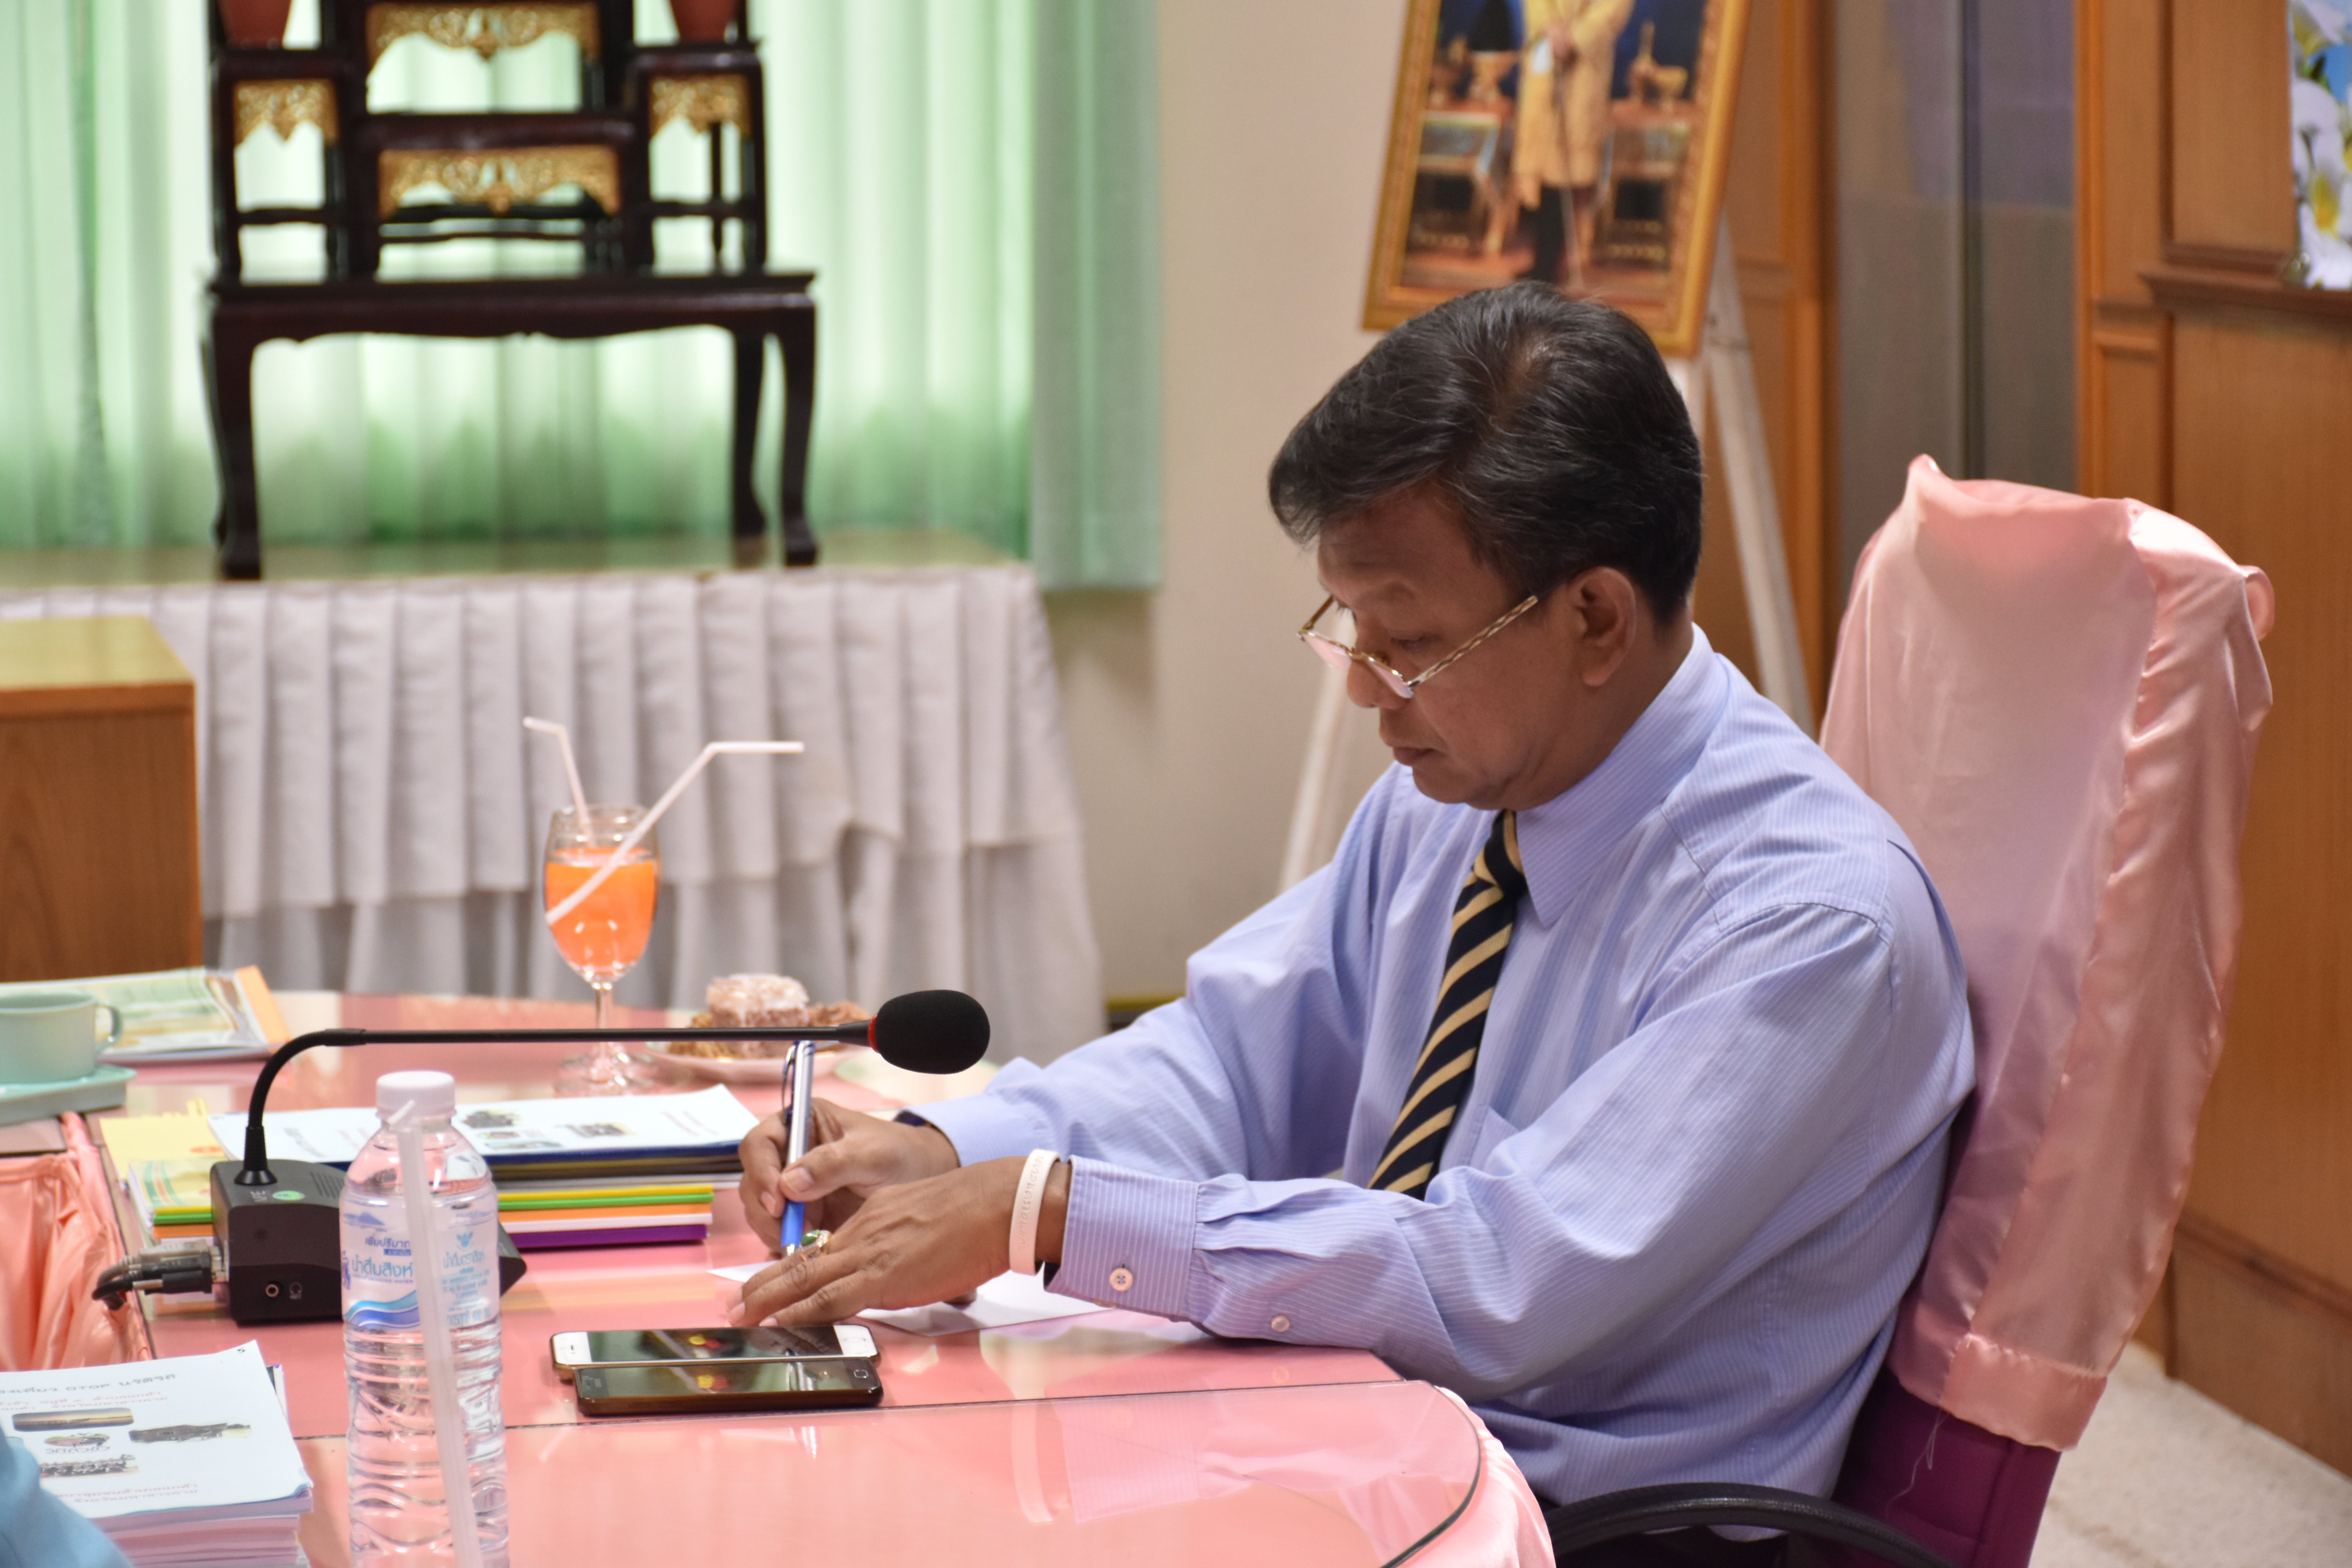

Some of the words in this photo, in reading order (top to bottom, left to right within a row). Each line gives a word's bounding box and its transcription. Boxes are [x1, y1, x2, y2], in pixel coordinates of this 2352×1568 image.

[352, 1254, 413, 1278] น้ำดื่มสิงห์
